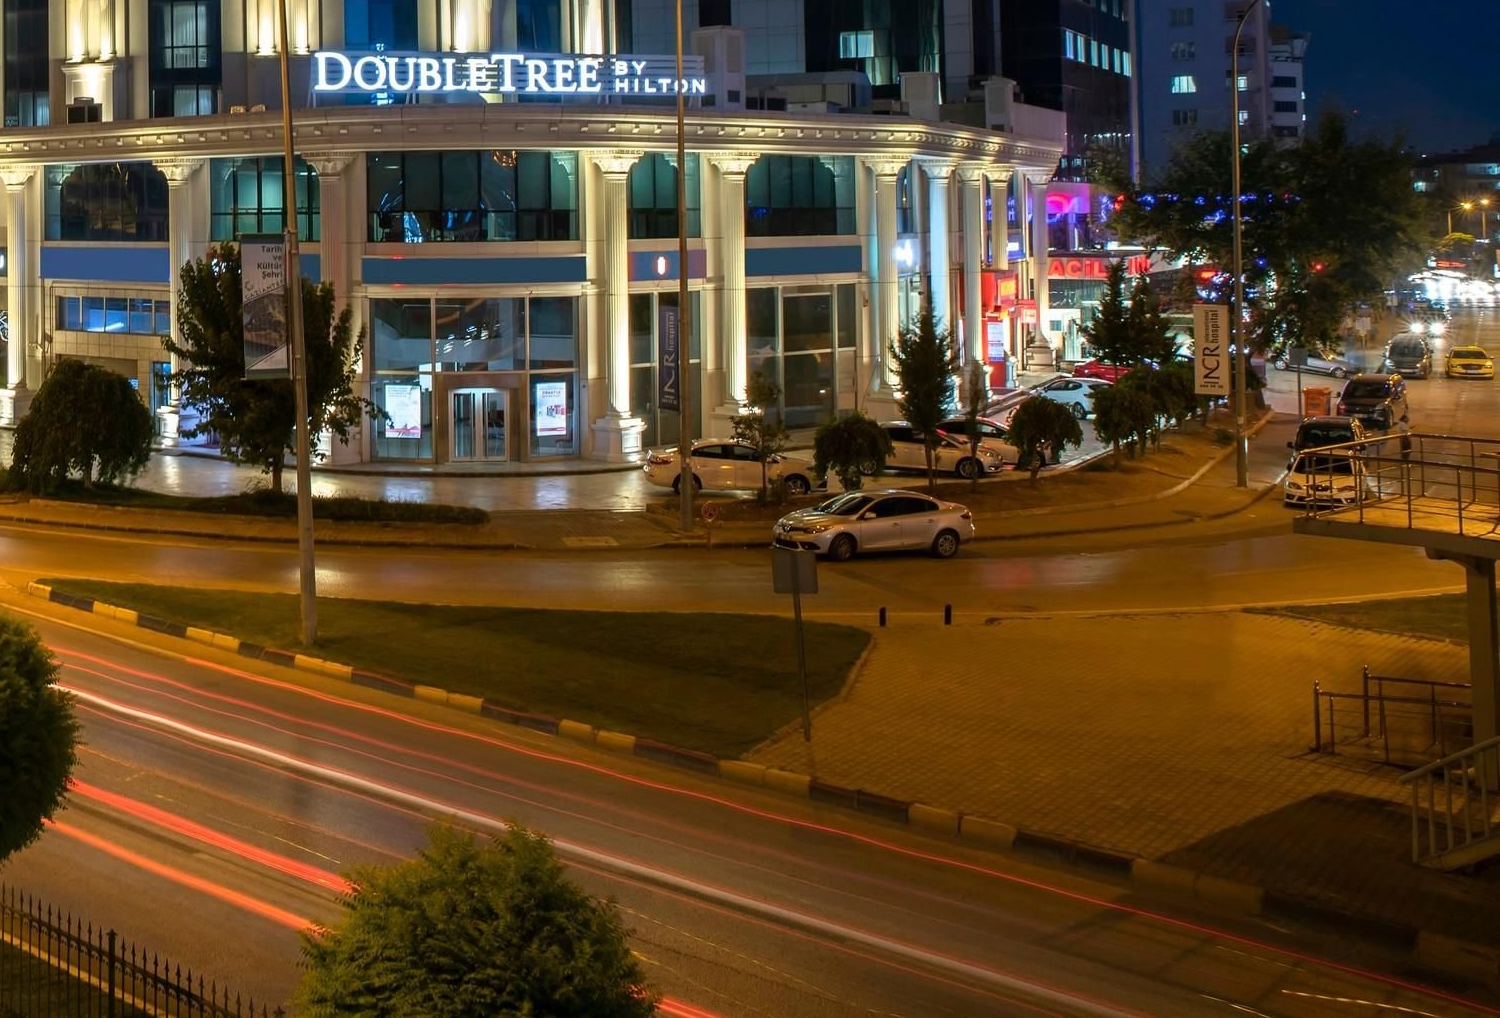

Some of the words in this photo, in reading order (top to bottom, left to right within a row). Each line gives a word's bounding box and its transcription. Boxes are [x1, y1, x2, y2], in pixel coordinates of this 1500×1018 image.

[314, 51, 602, 93] DOUBLETREE
[614, 61, 647, 77] BY
[614, 78, 706, 94] HILTON
[261, 245, 282, 253] Tarih
[257, 262, 282, 270] Kültür
[262, 270, 283, 280] Şehri
[1210, 309, 1220, 343] hospital
